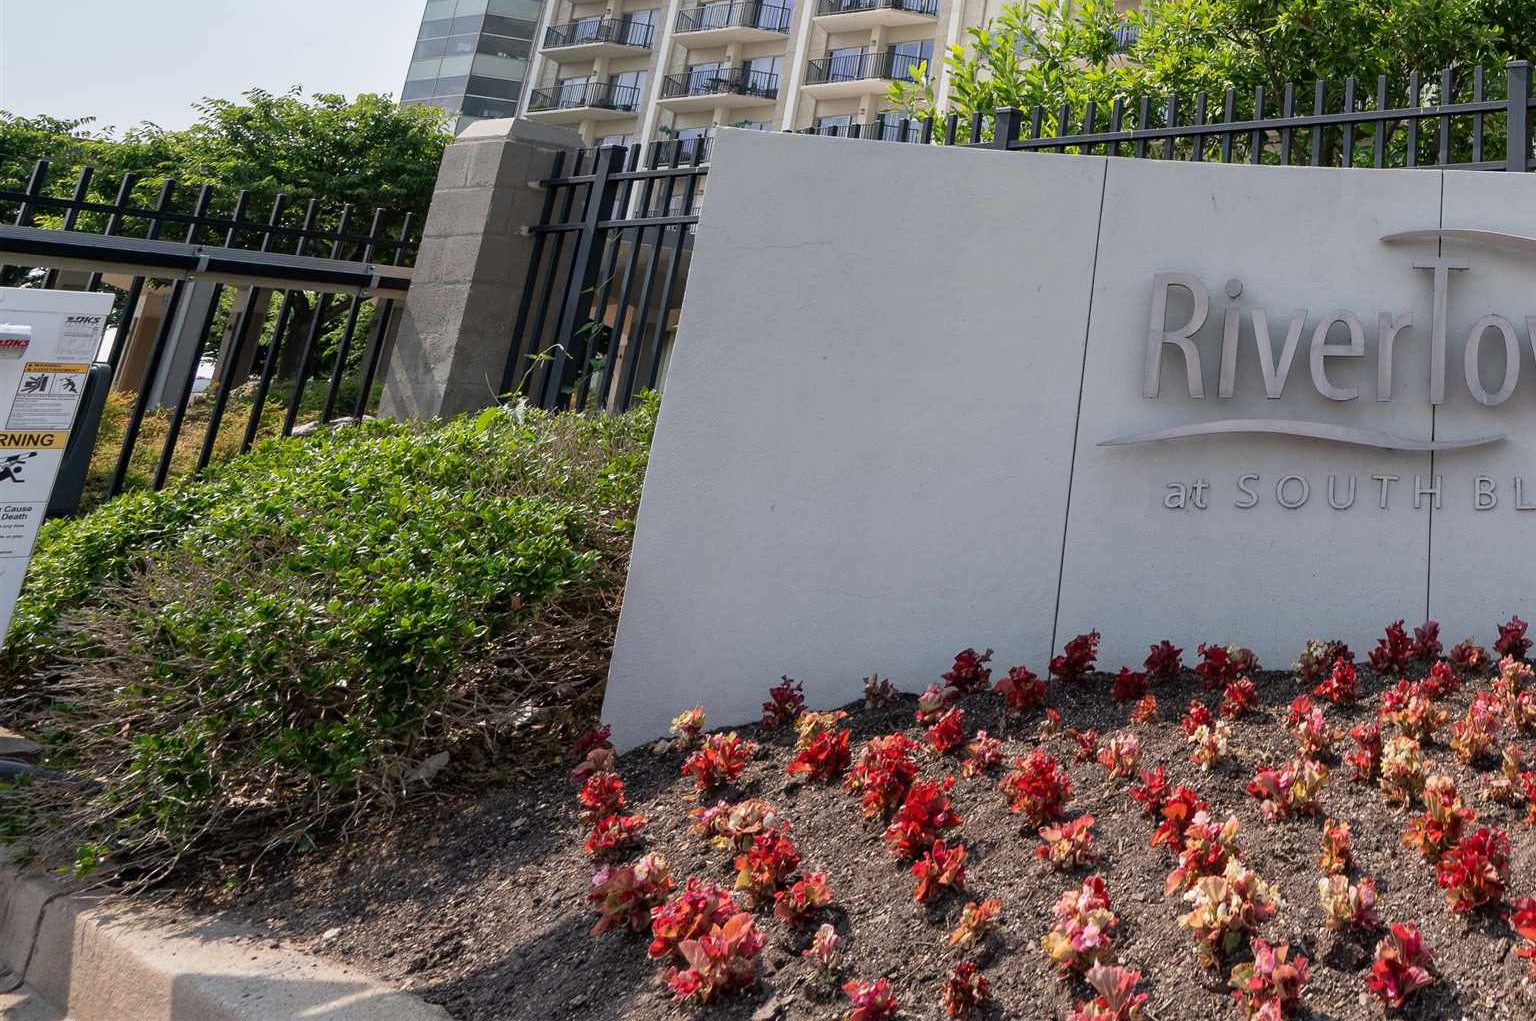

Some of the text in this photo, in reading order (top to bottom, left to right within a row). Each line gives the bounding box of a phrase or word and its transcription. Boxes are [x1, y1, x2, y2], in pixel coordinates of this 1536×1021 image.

[1162, 478, 1210, 510] at
[1234, 473, 1443, 511] SOUTH
[4, 505, 33, 513] Cause
